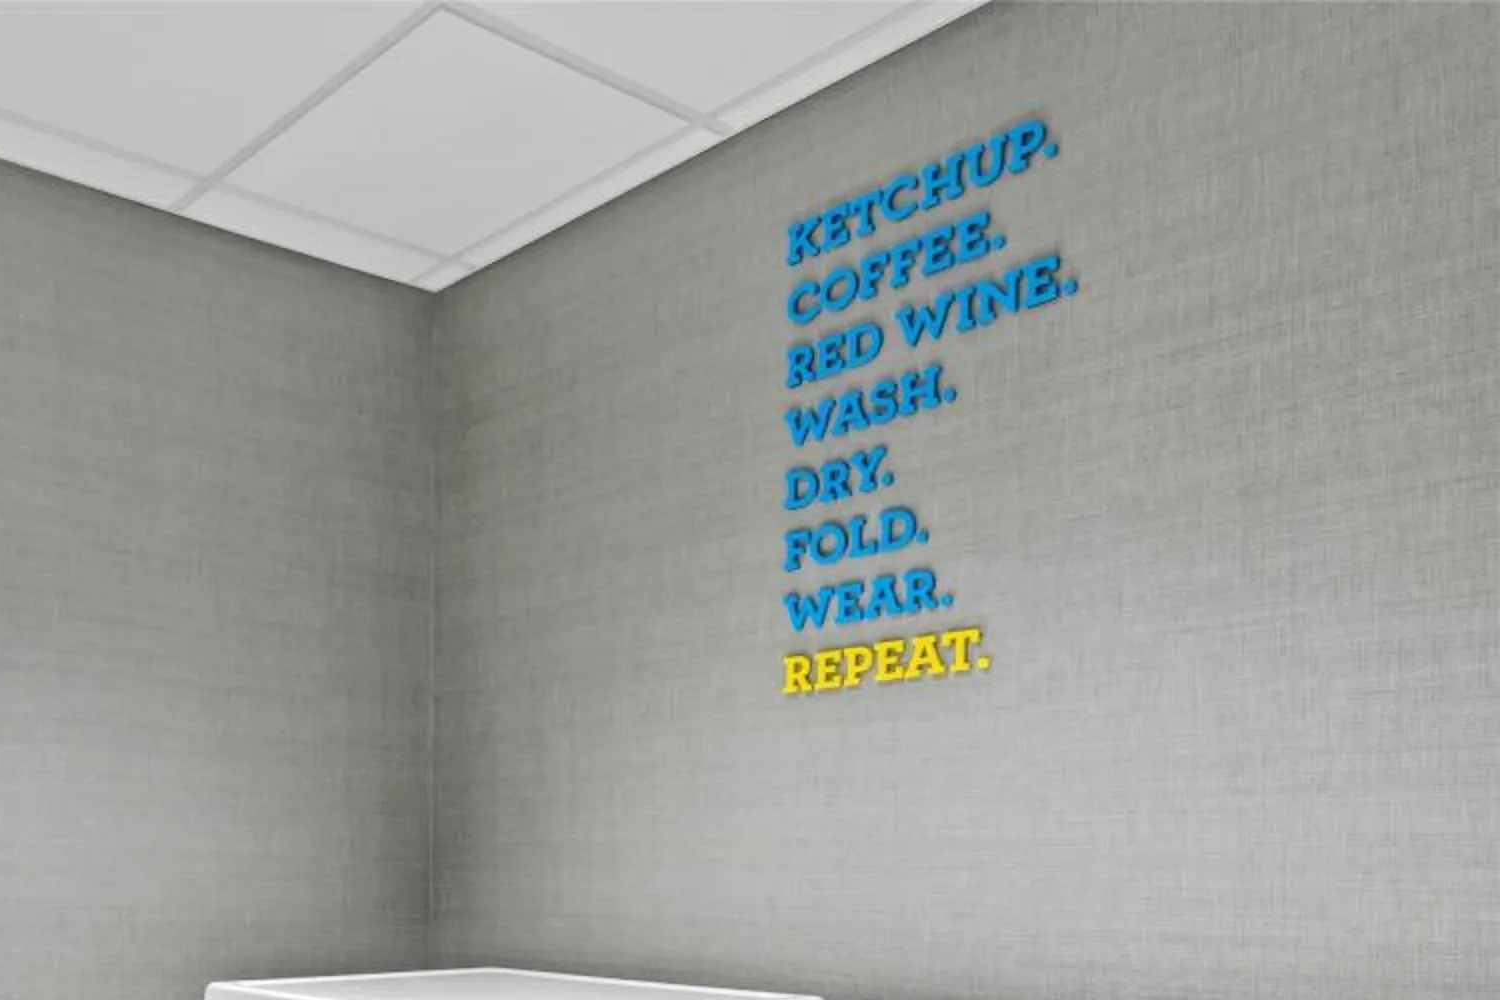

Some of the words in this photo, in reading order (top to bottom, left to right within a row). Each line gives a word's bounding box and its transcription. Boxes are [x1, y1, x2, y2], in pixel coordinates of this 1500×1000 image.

[785, 119, 1060, 266] KETCHUP.
[786, 211, 1008, 325] COFFEE.
[785, 321, 885, 388] RED
[895, 254, 1079, 347] WINE.
[784, 363, 957, 447] WASH.
[784, 444, 895, 510] DRY.
[783, 505, 930, 572] FOLD.
[783, 568, 955, 632] WEAR.
[782, 628, 991, 695] REPEAT.
